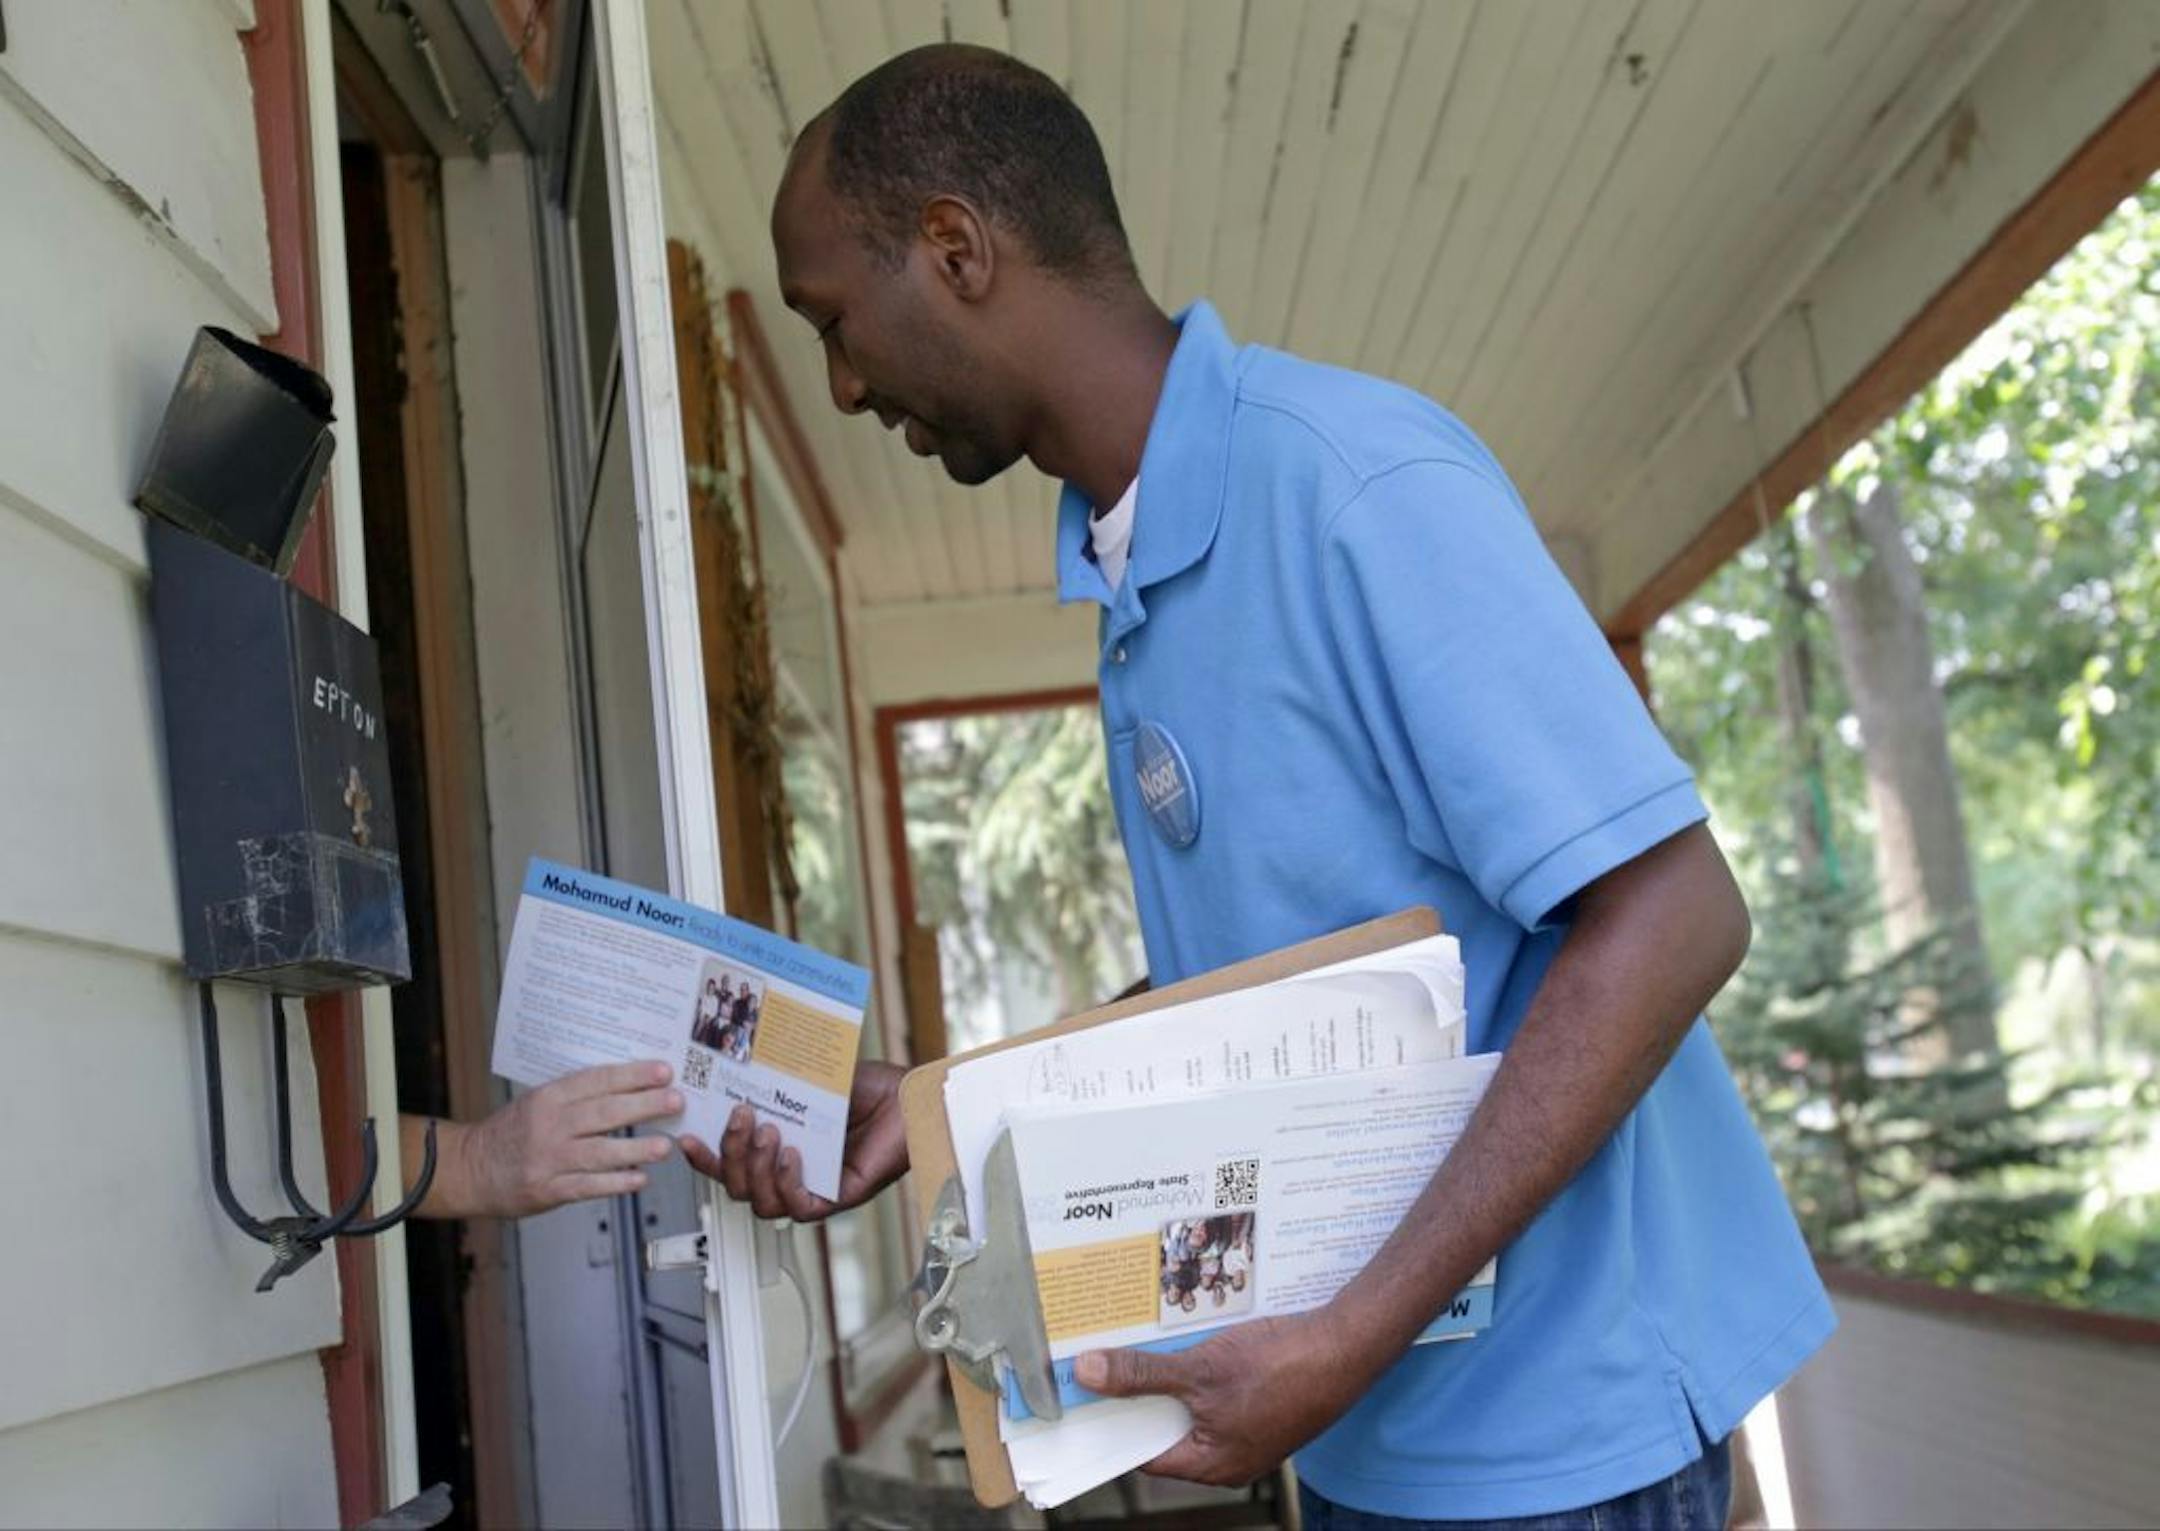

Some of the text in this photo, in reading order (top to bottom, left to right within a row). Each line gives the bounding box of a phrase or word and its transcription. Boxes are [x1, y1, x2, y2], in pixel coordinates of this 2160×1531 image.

[313, 677, 376, 740] EPTON
[1137, 758, 1178, 803] Noor
[542, 873, 632, 911] Mohamud
[636, 901, 684, 927] Noor:
[773, 1088, 808, 1114] Noor
[1065, 1174, 1189, 1200] State Representative
[1062, 1201, 1112, 1222] Noor
[1116, 1188, 1203, 1216] Mohamud
